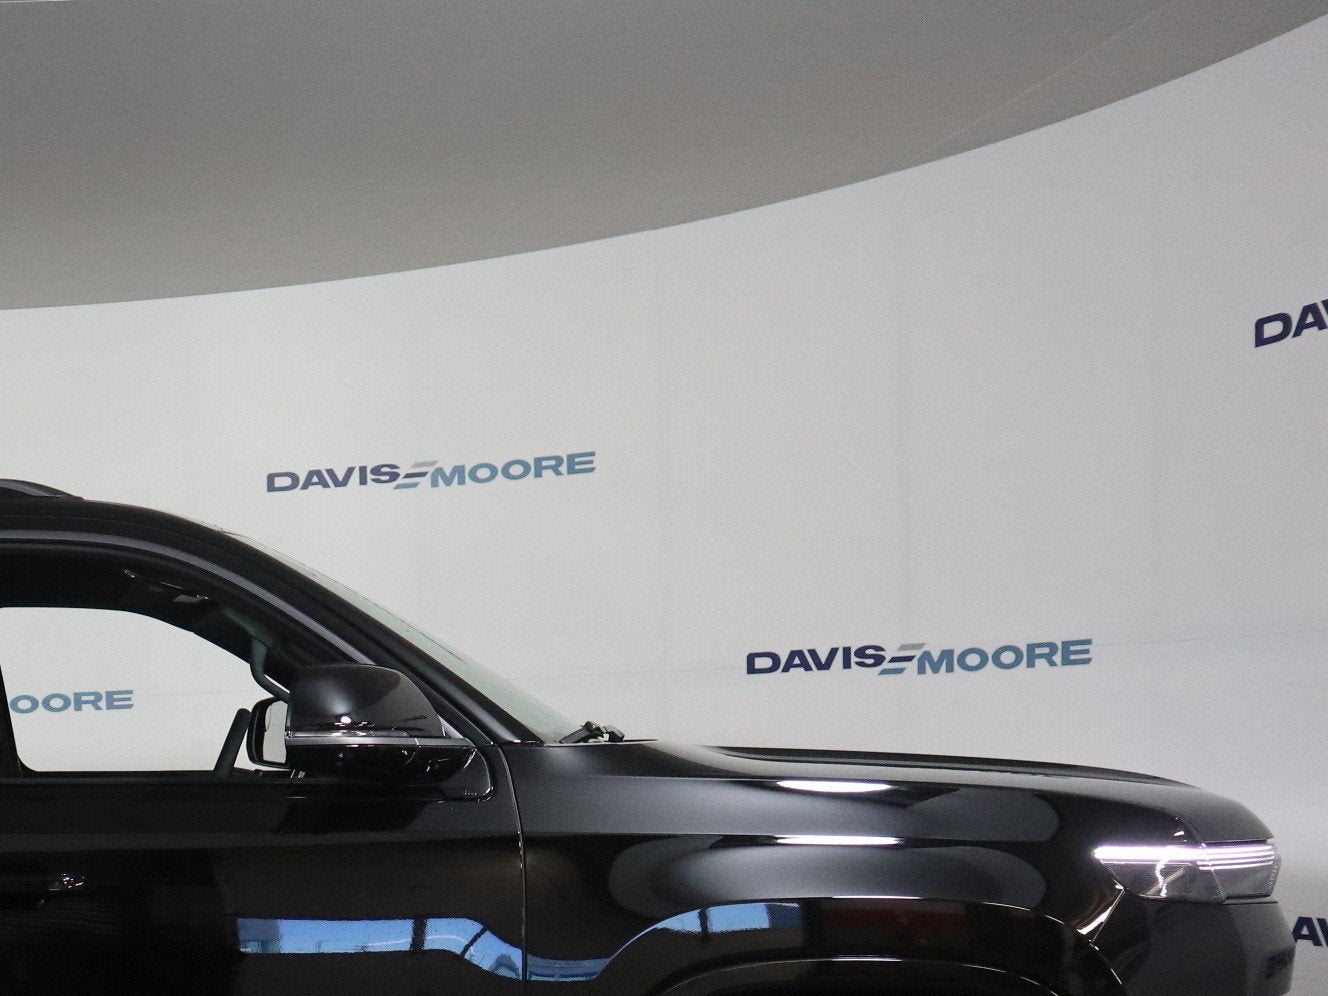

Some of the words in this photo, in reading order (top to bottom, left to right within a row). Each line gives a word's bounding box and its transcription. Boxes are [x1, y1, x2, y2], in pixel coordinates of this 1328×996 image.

[1254, 298, 1328, 348] DA
[266, 463, 400, 493] DAVIS
[430, 451, 596, 489] MOORE
[746, 644, 886, 675] DAVIS
[917, 638, 1093, 675] MOORE
[9, 689, 134, 714] OORE
